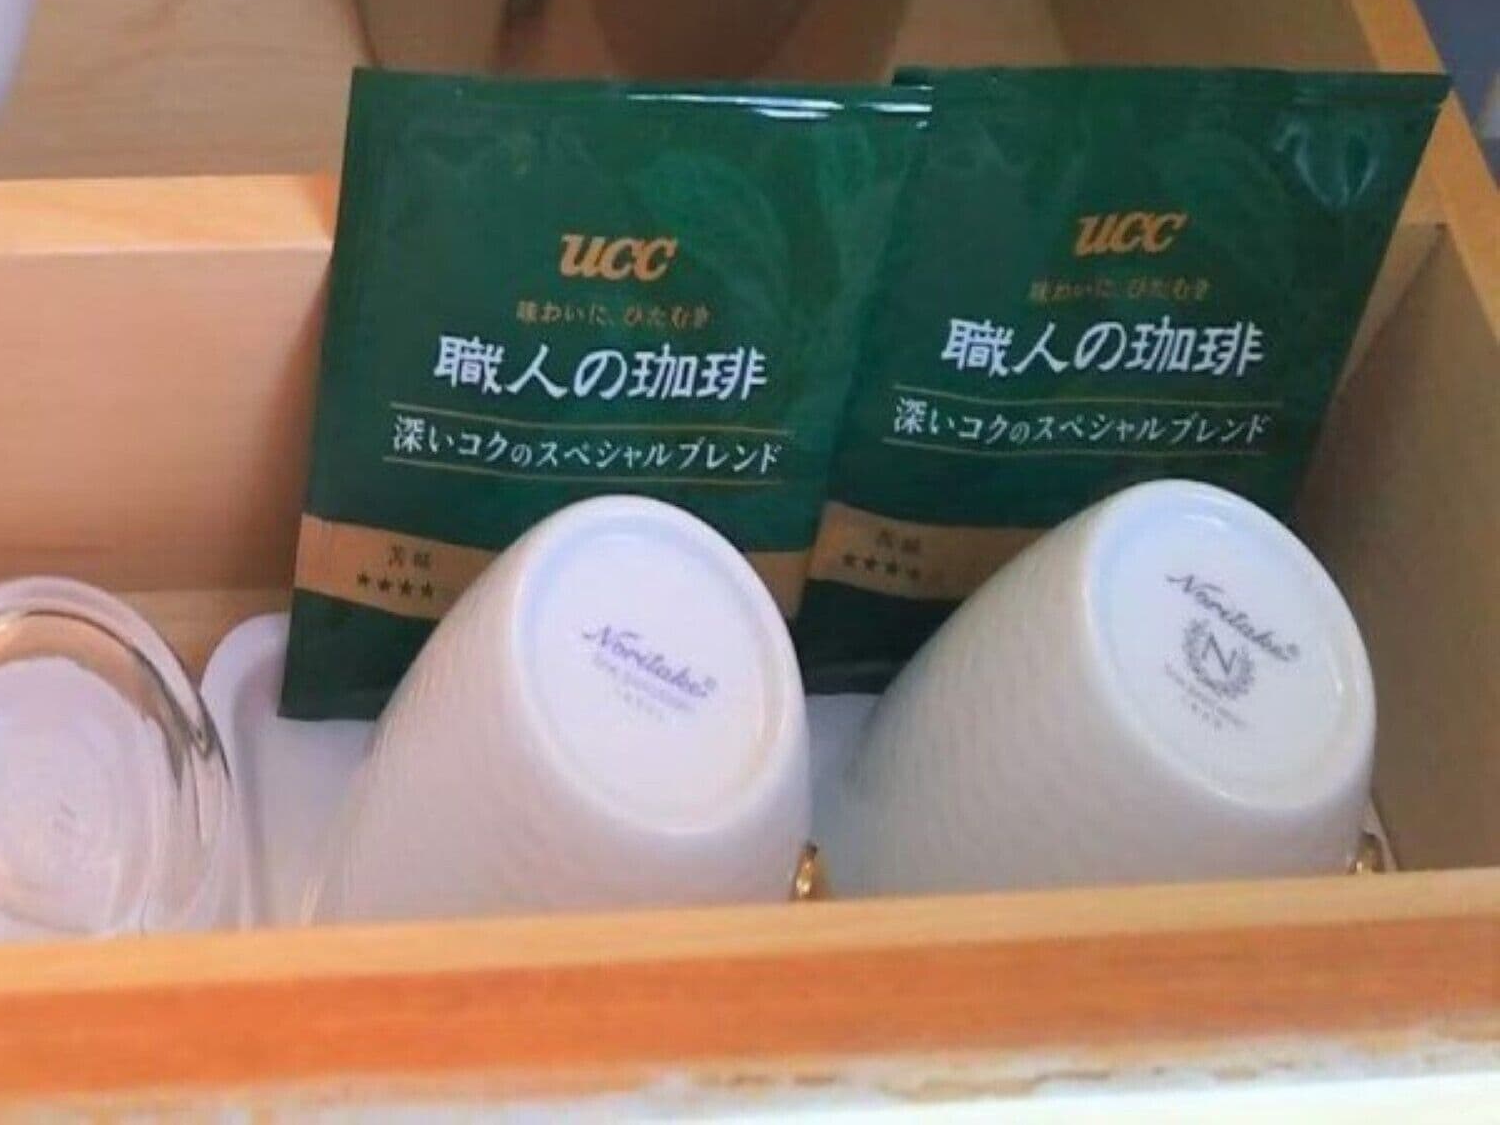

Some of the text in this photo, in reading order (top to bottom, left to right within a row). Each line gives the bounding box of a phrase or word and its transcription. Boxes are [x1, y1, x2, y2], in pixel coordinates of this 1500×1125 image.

[434, 334, 768, 402] 職人の珈琲
[941, 315, 1266, 377] 職人の珈琲
[392, 413, 783, 474] 深いコクのスペシャルブレンド
[893, 396, 1273, 446] 深いコクのスペシャルブレンド
